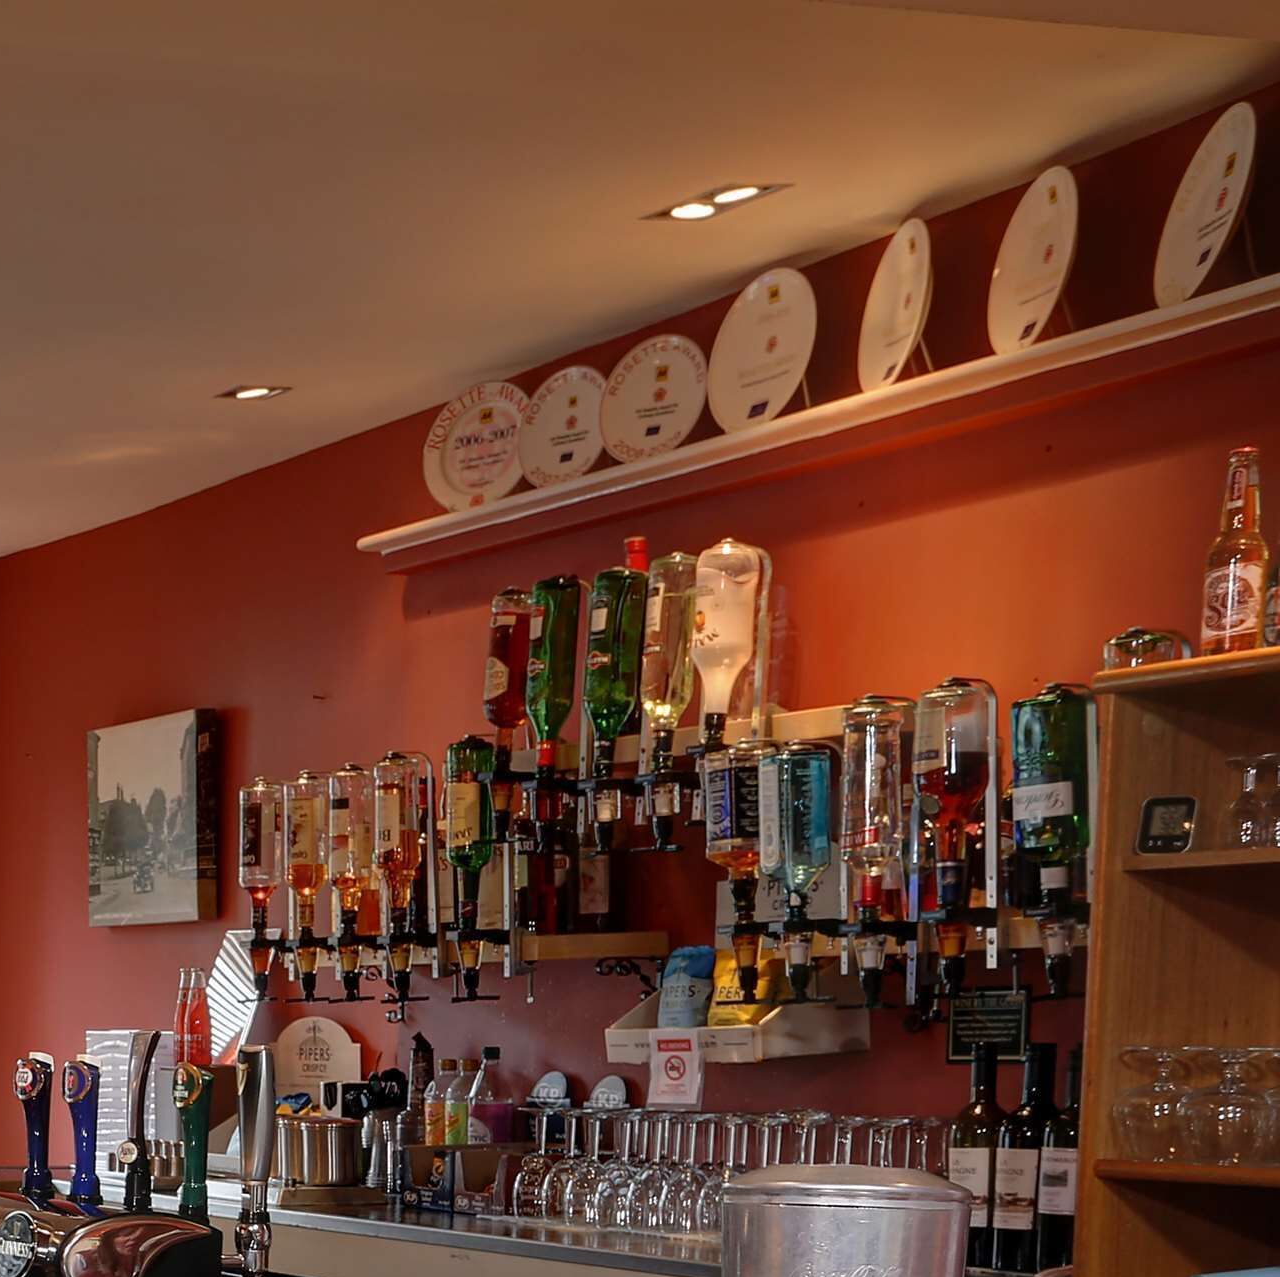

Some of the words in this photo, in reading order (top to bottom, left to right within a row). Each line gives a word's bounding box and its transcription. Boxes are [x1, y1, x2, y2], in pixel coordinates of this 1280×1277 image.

[427, 386, 487, 450] ROSETTE
[492, 383, 531, 418] AWAR
[454, 424, 518, 450] 2006-2007
[298, 1047, 330, 1062] PIPERS
[597, 1093, 618, 1108] KP
